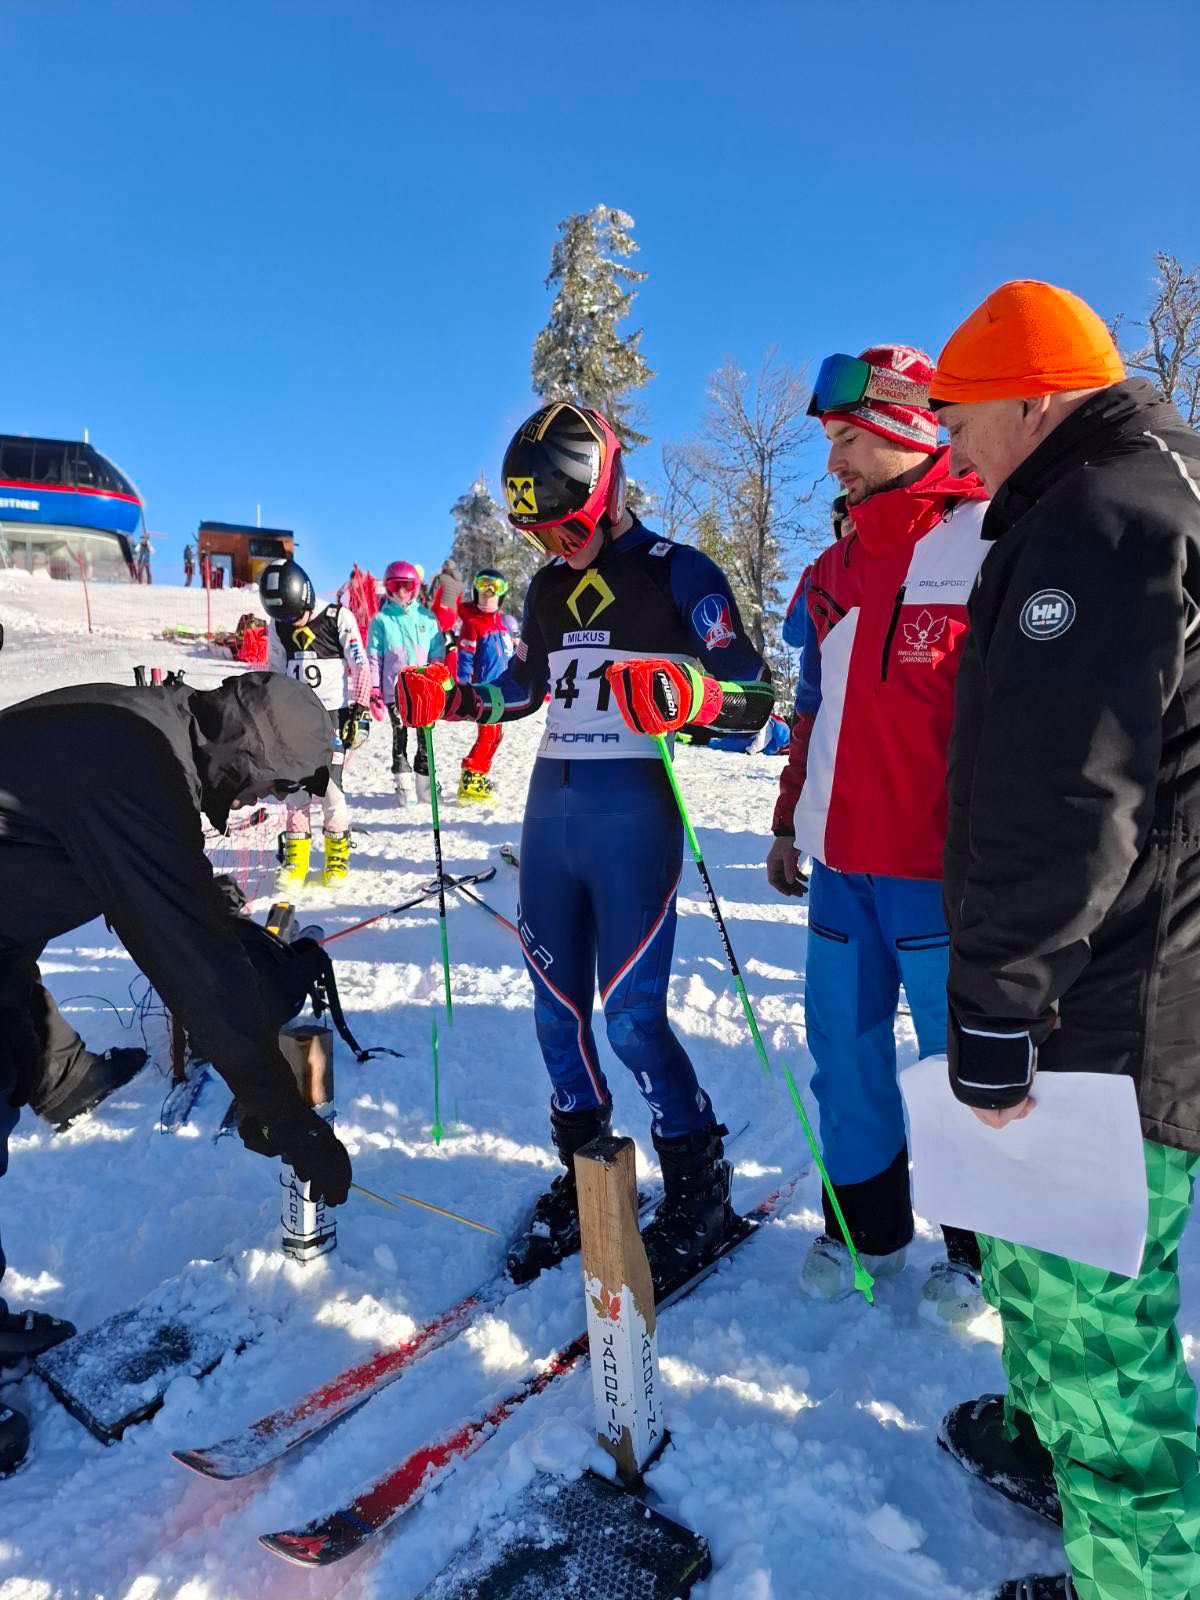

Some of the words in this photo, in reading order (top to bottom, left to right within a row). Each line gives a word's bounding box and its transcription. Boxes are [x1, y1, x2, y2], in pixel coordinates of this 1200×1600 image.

[1032, 602, 1062, 620] HH
[567, 632, 605, 643] MILKUS
[292, 664, 322, 689] 19
[554, 658, 615, 712] 41
[656, 672, 678, 717] reusch
